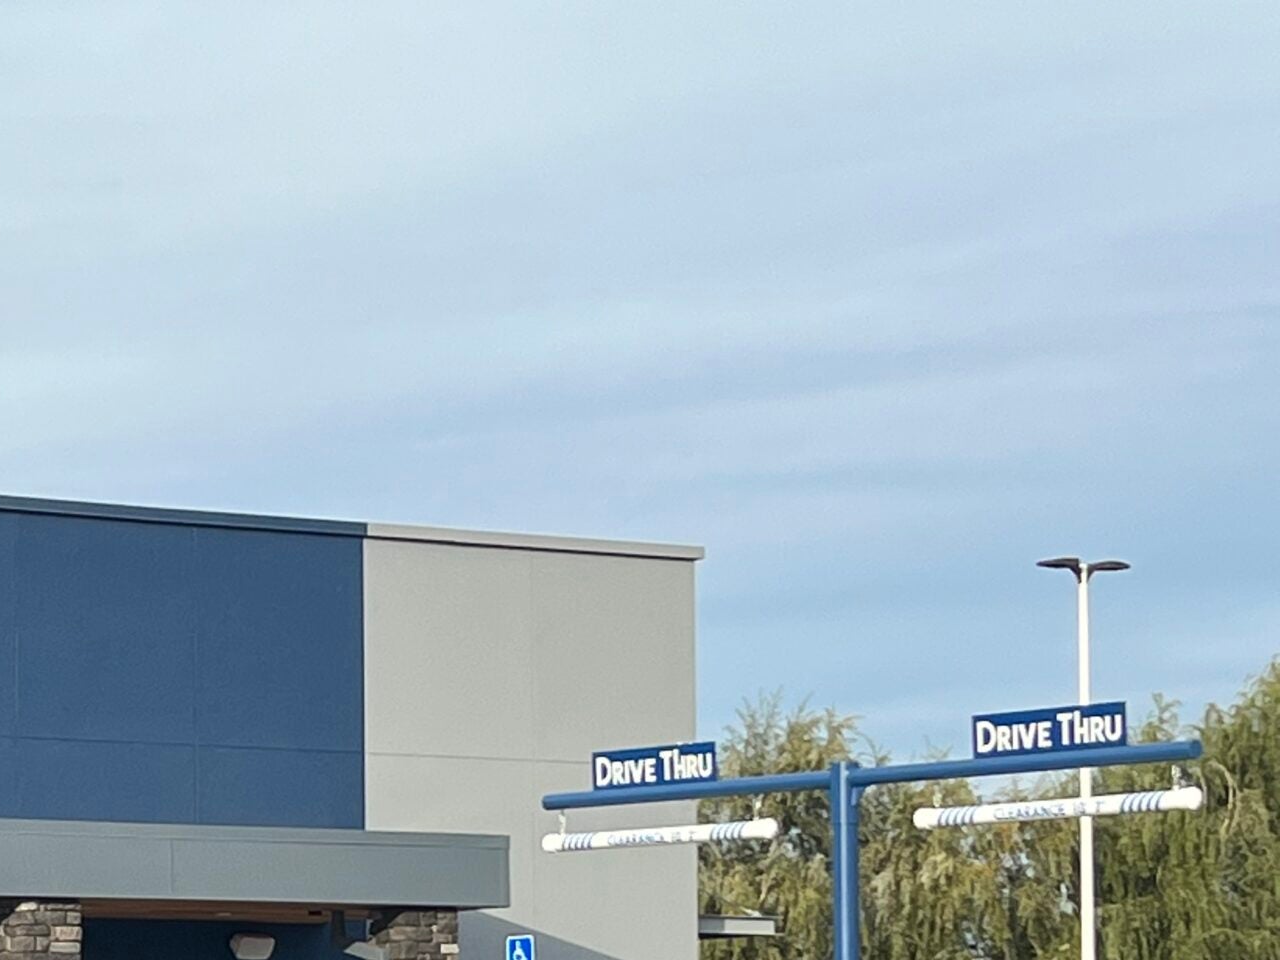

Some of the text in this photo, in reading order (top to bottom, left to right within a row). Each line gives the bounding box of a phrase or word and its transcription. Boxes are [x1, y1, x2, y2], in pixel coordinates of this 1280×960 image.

[975, 710, 1122, 753] DRIVE THRU
[595, 748, 713, 788] DRIVE THRU
